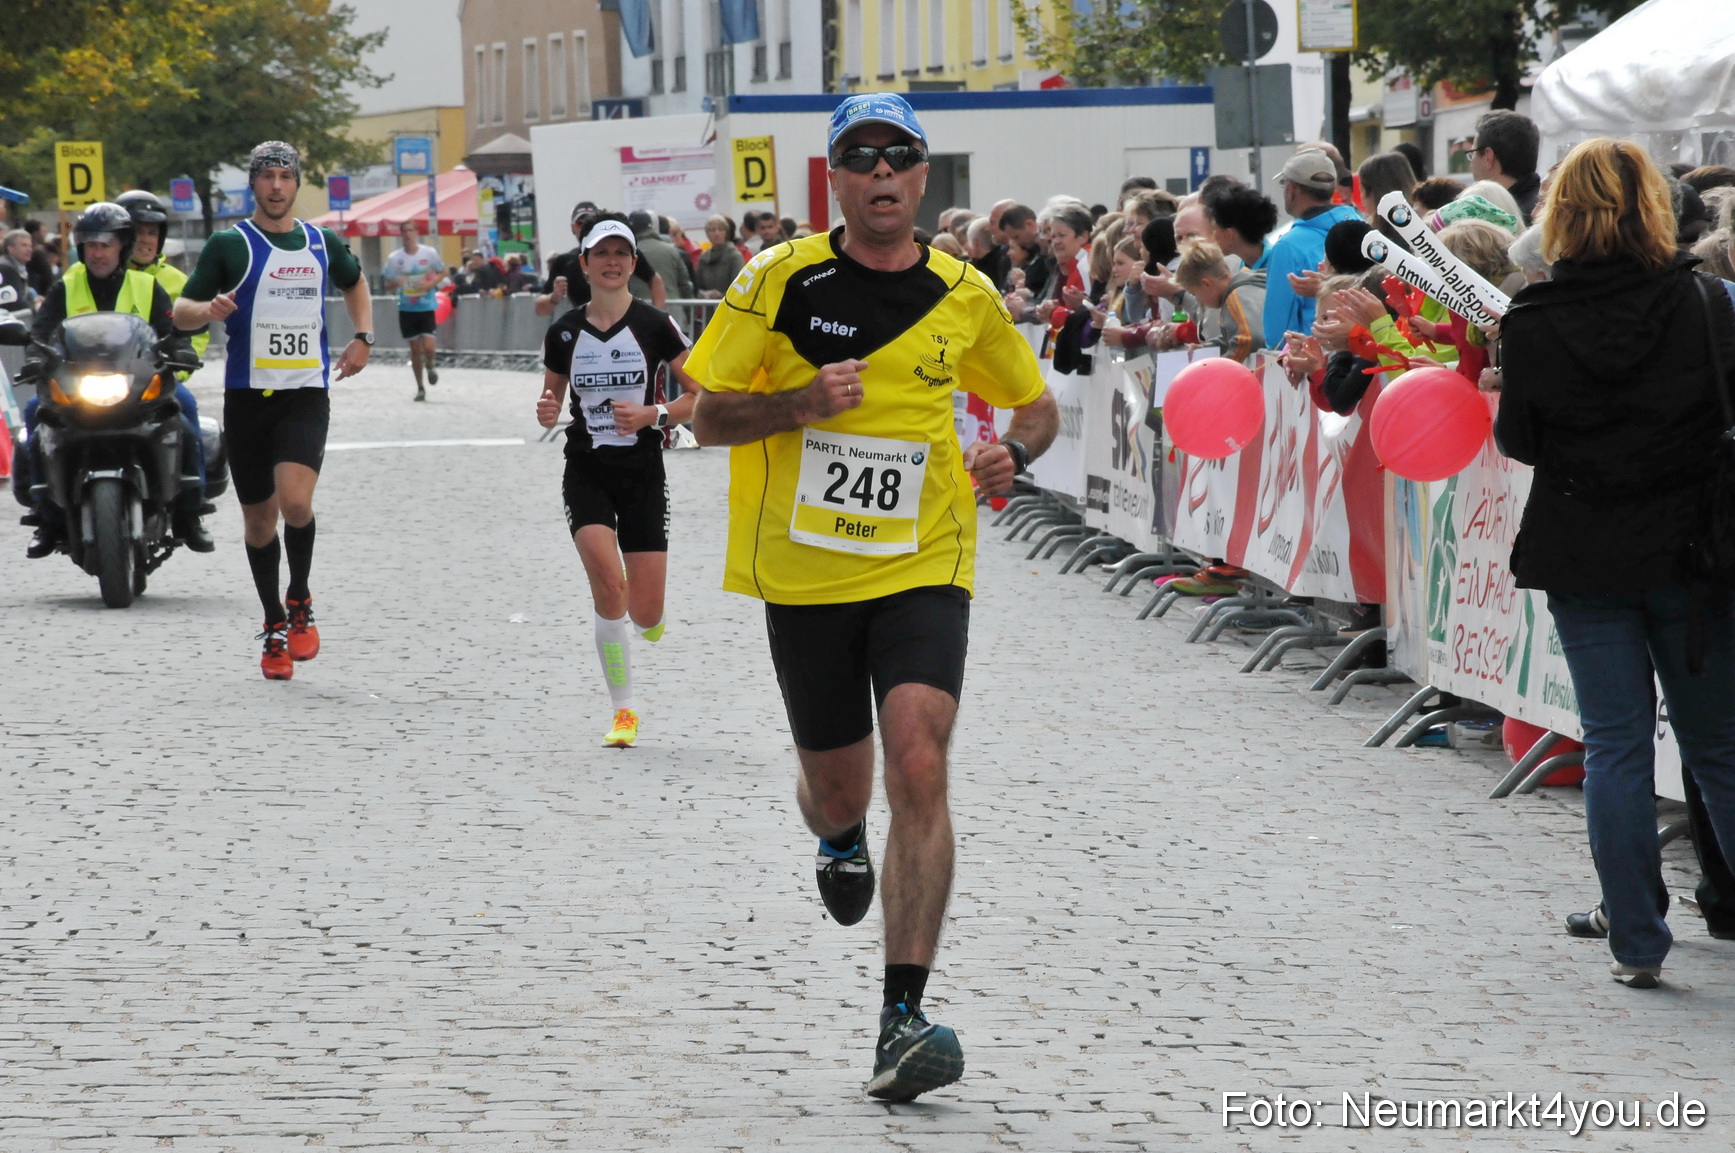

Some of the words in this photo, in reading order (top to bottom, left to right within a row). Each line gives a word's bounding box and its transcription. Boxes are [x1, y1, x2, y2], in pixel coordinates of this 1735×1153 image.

[61, 146, 97, 157] Block
[736, 140, 769, 151] Block
[69, 163, 92, 194] D
[744, 157, 766, 188] D
[802, 267, 836, 287] STANNO
[256, 322, 279, 331] PARTL
[810, 316, 857, 338] Peter
[269, 332, 309, 356] 536
[930, 334, 949, 346] TSV
[575, 372, 642, 387] POSITIV
[806, 439, 846, 457] PARTL
[849, 447, 907, 463] Neumarkt
[823, 461, 902, 511] 248
[835, 517, 877, 538] Peter
